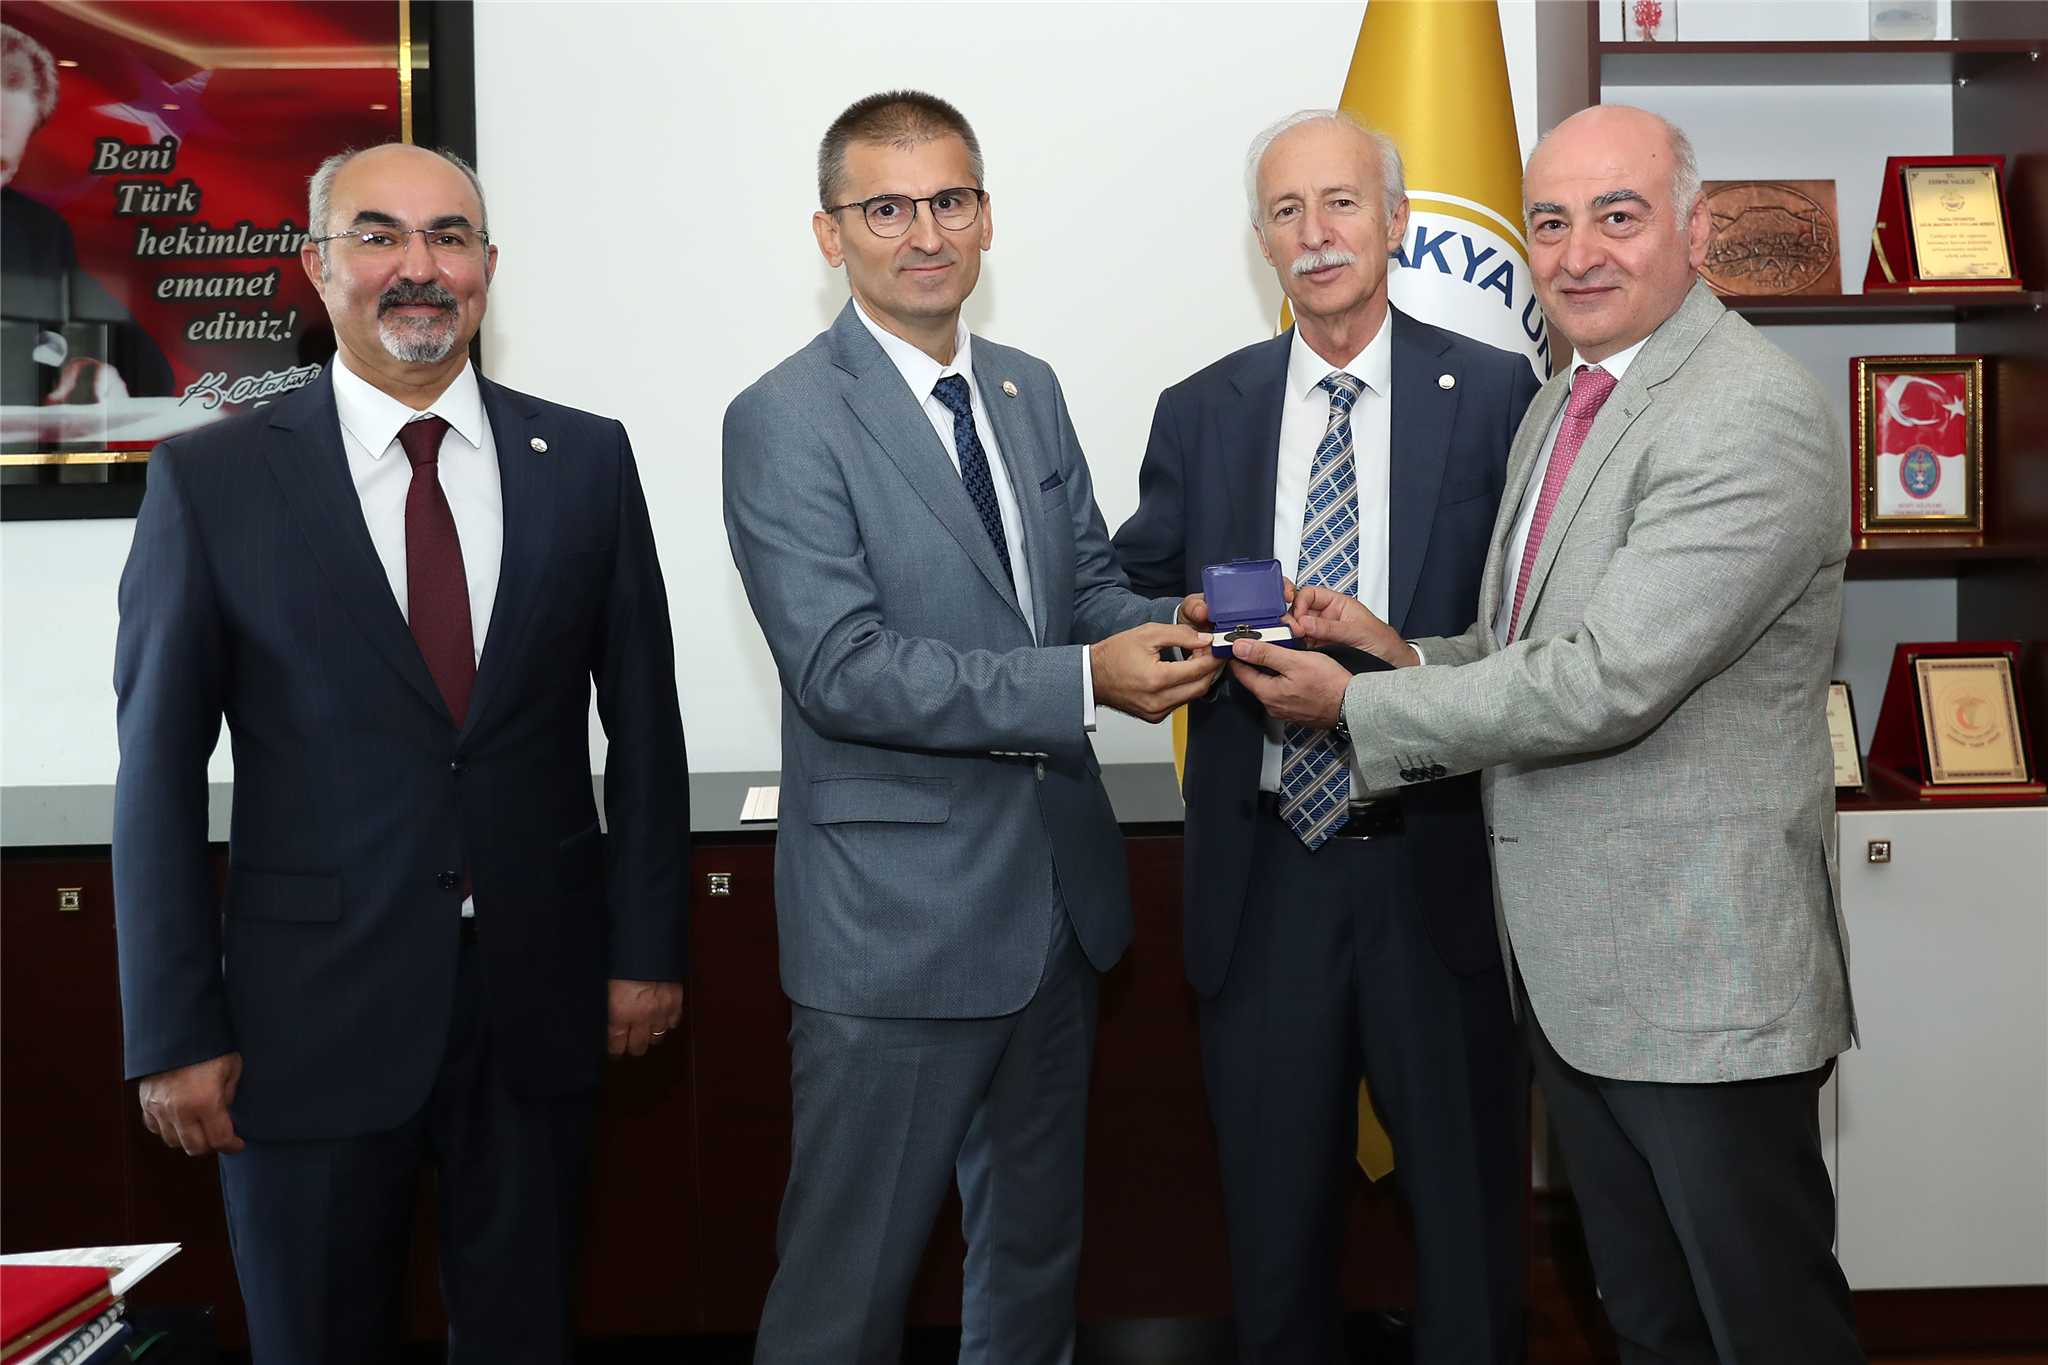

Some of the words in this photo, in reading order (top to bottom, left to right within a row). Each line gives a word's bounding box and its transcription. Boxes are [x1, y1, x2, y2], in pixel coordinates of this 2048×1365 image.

[94, 141, 173, 171] Beni
[118, 184, 196, 213] Türk
[157, 272, 275, 299] emanet
[187, 310, 297, 342] ediniz!
